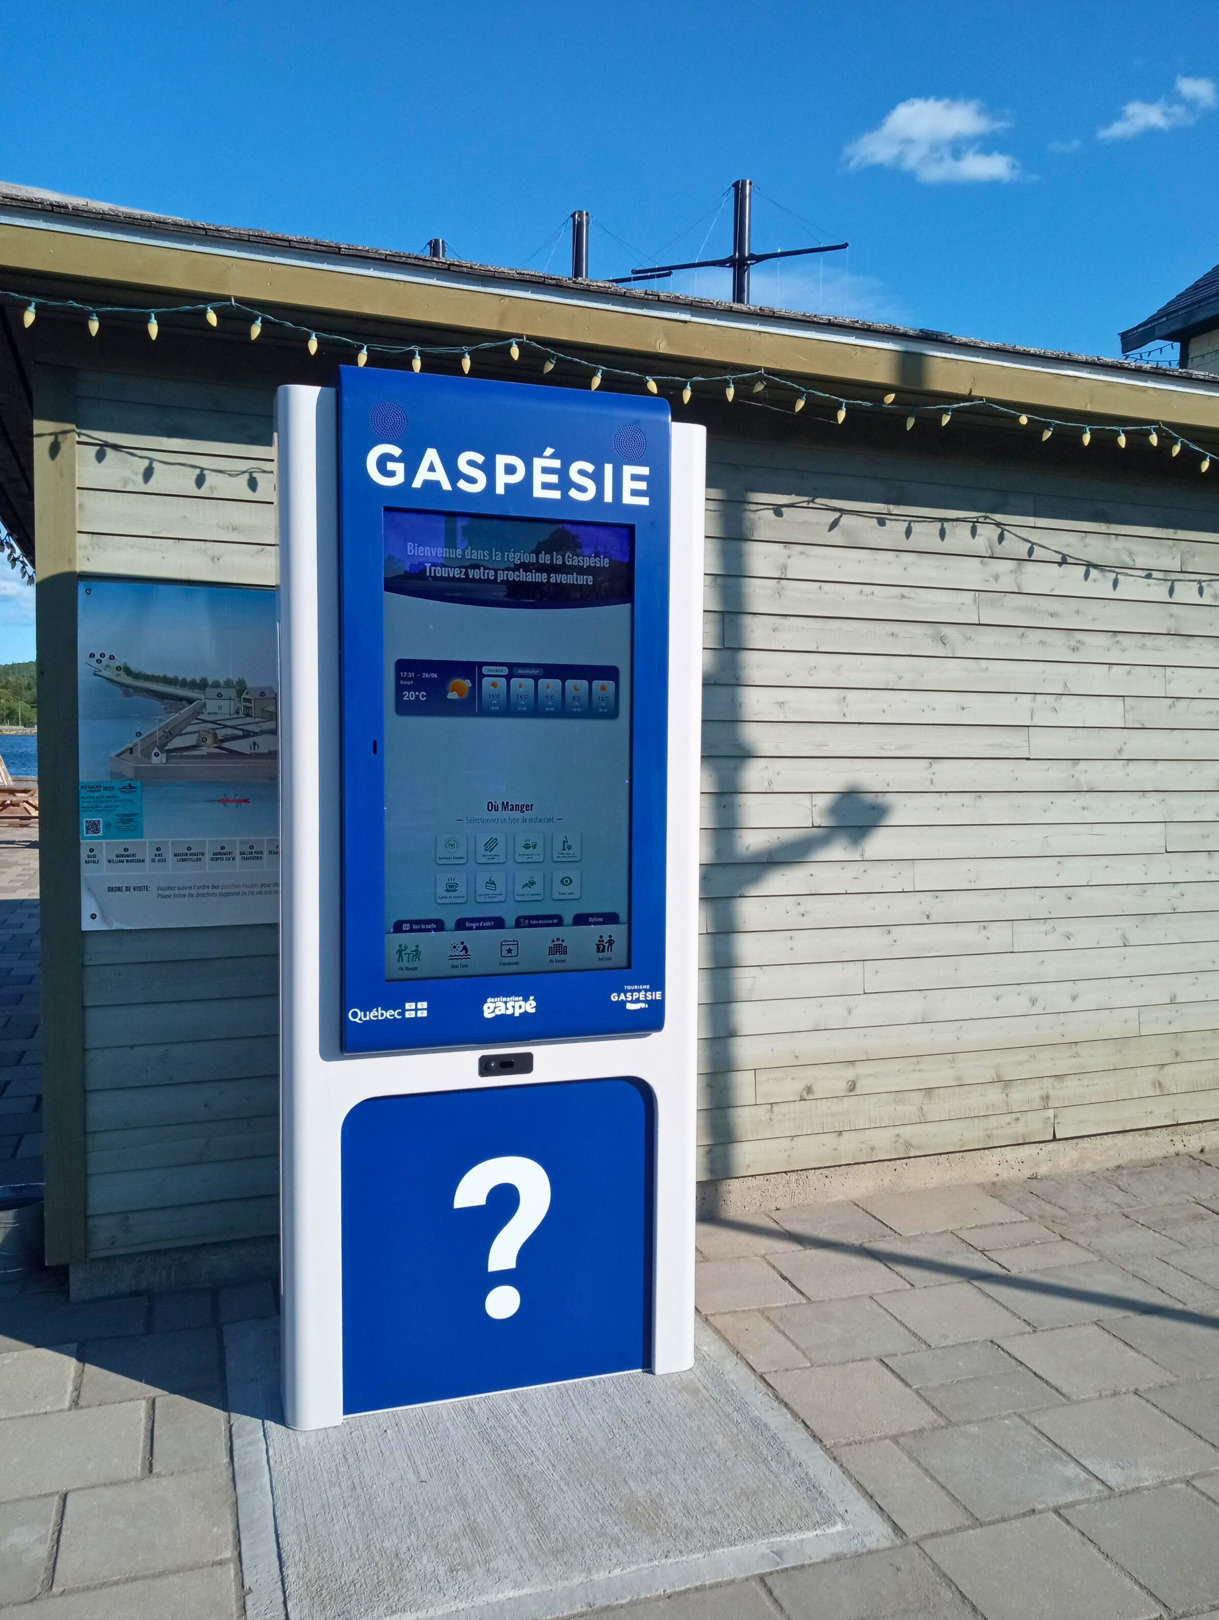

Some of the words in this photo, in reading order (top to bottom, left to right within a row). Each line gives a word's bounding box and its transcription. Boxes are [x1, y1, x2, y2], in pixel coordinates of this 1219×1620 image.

[366, 443, 650, 506] GASPÉSIE
[407, 542, 462, 559] Bienvenue
[465, 546, 489, 561] dans
[492, 547, 502, 561] la
[504, 549, 536, 565] région
[538, 550, 551, 564] de
[553, 551, 563, 565] la
[565, 552, 610, 569] Gaspésie
[425, 563, 466, 578] Trouvez
[468, 566, 495, 580] votre
[497, 569, 548, 583] prochaine
[550, 572, 594, 585] aventure
[402, 691, 427, 701] 20°C
[487, 801, 499, 812] Où
[501, 801, 535, 814] Manger
[610, 990, 662, 1002] GASPÉSIE
[348, 1006, 403, 1024] Québec
[483, 996, 537, 1019] gaspé
